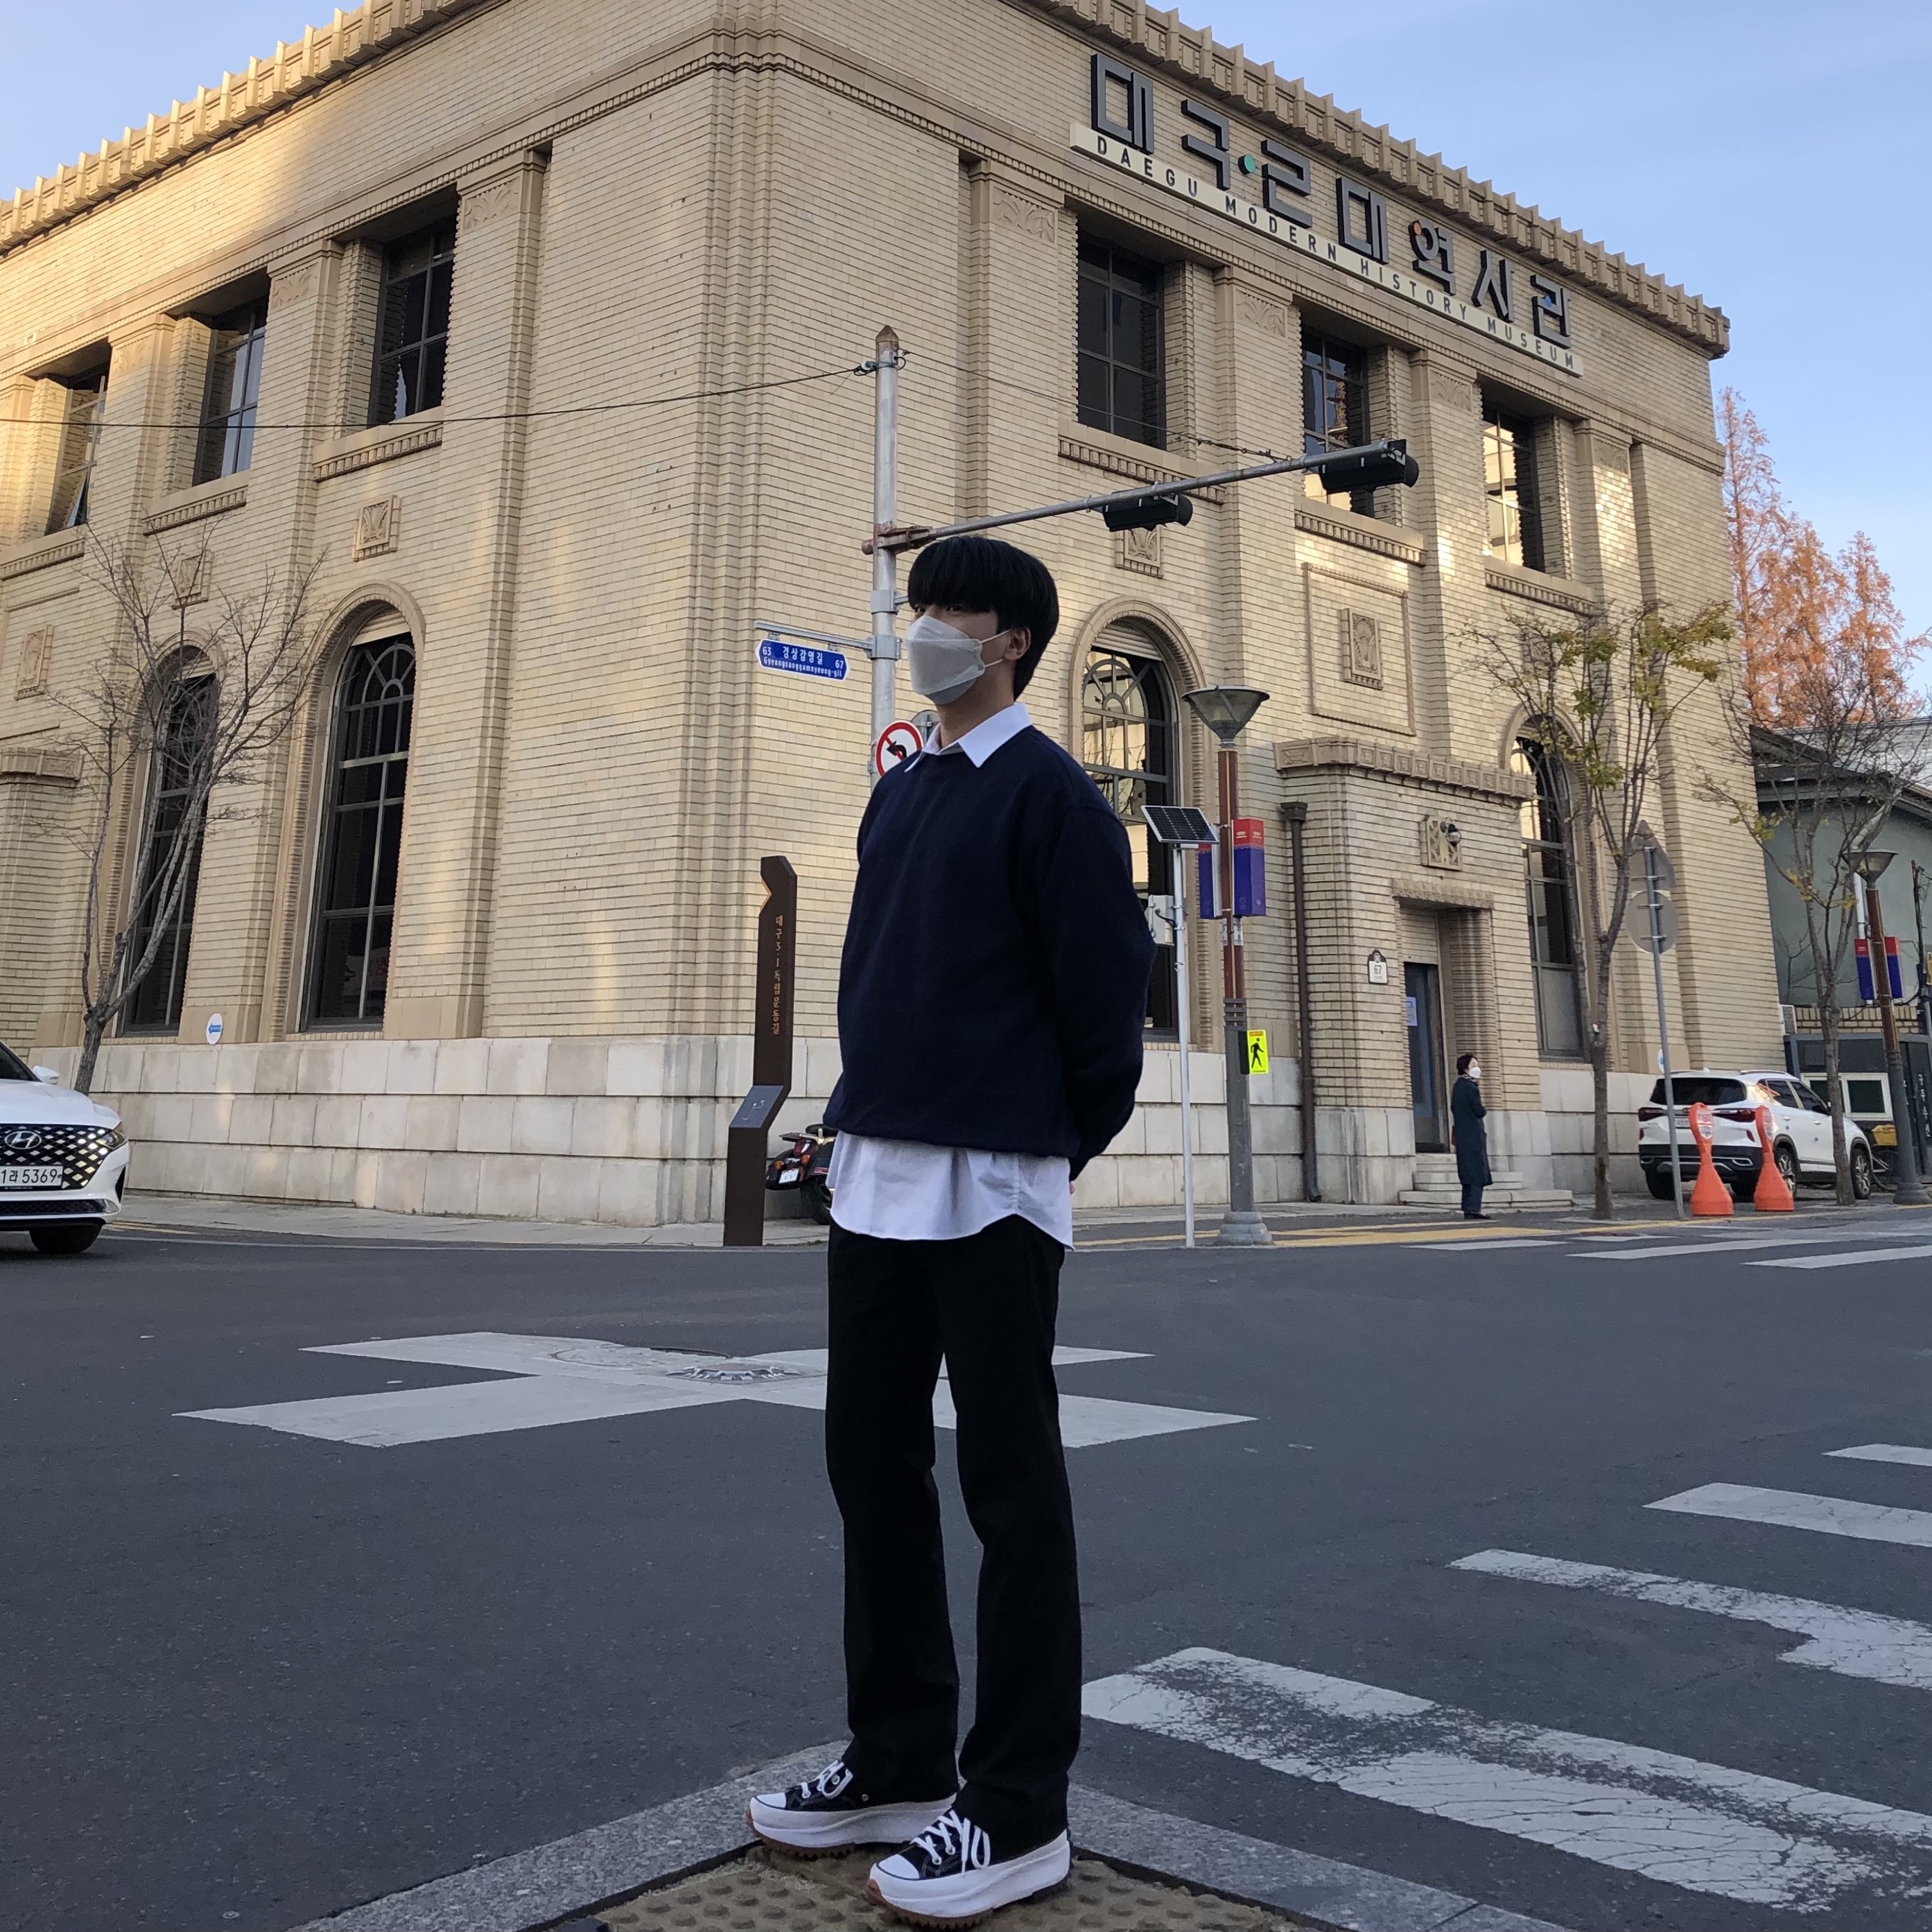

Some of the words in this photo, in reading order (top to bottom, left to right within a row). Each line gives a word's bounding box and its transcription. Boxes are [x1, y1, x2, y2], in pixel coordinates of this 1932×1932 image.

[1097, 135, 1199, 198] DAEGU
[1225, 195, 1337, 262] MODERN
[1360, 258, 1468, 320] HISTORY
[1487, 316, 1574, 369] MUSEUM
[763, 646, 772, 656] 63
[783, 646, 823, 665] 경상감영길
[835, 659, 844, 669] 67
[763, 656, 842, 678] Gyeongsanggamnyeong-gil
[1374, 964, 1382, 975] 67
[21, 1168, 58, 1184] 5369
